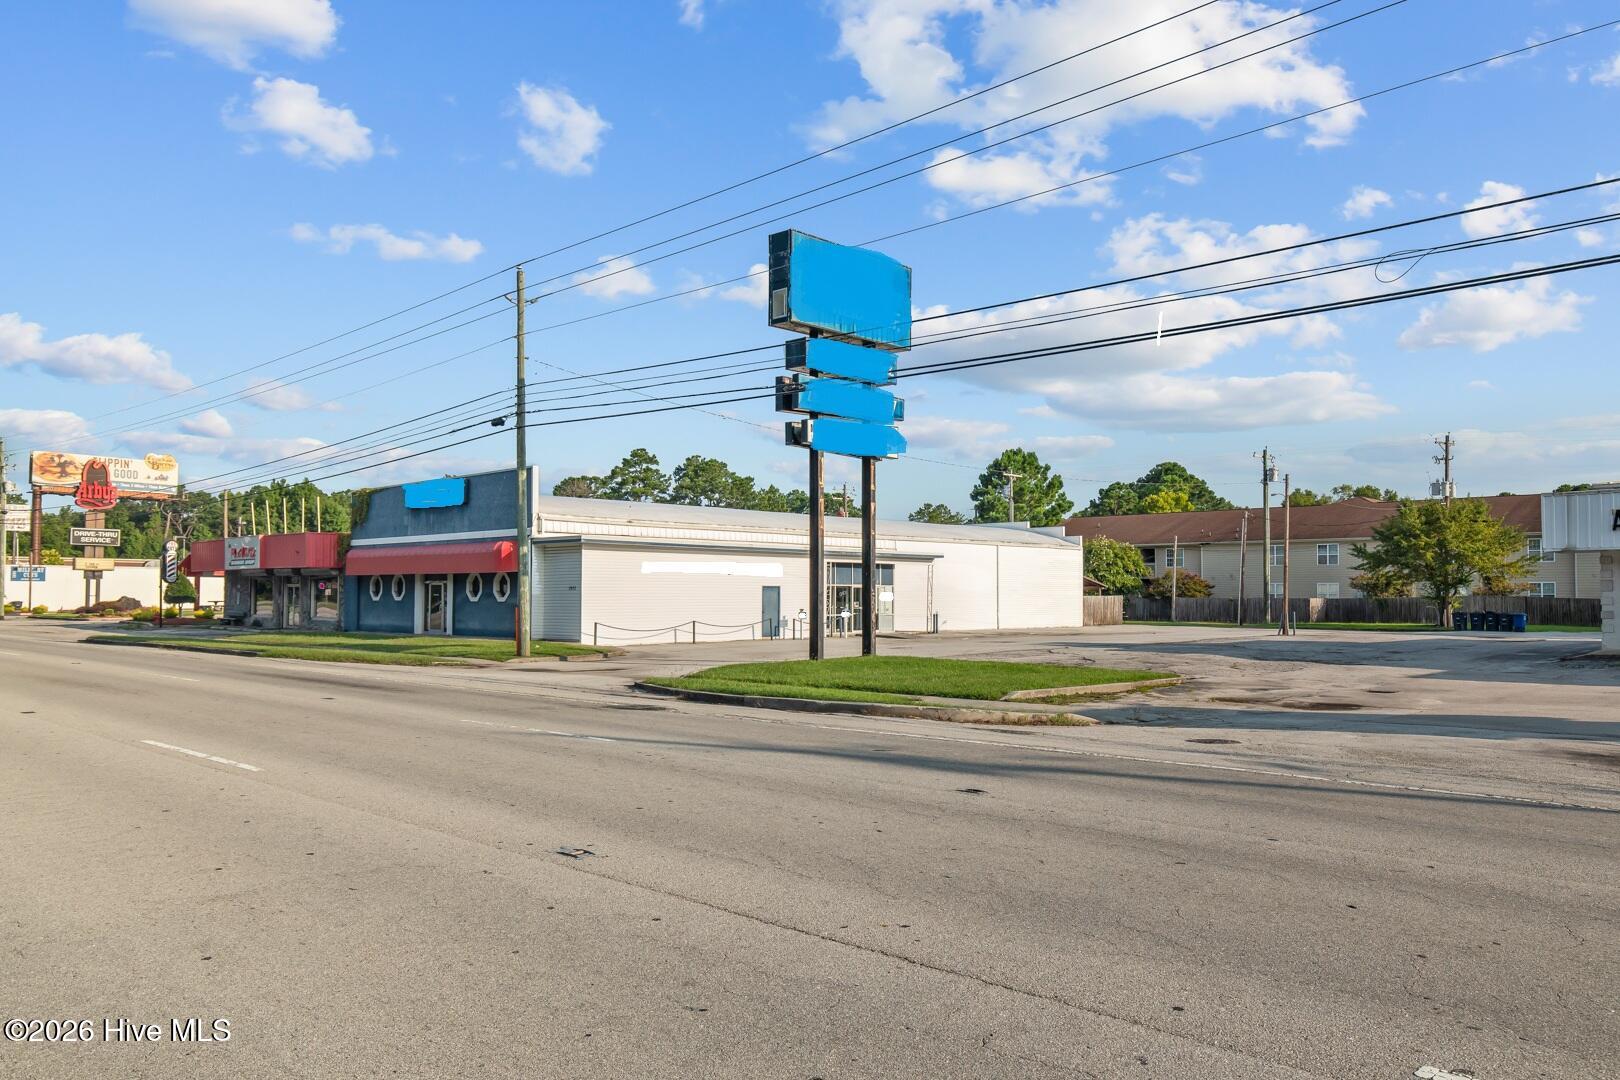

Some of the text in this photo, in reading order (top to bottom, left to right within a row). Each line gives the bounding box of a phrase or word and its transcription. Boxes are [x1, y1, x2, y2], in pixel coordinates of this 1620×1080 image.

[92, 457, 133, 469] IPPIN'
[113, 469, 139, 480] GOOD
[75, 480, 118, 502] Arby's
[73, 530, 118, 538] DRIVE-THRU
